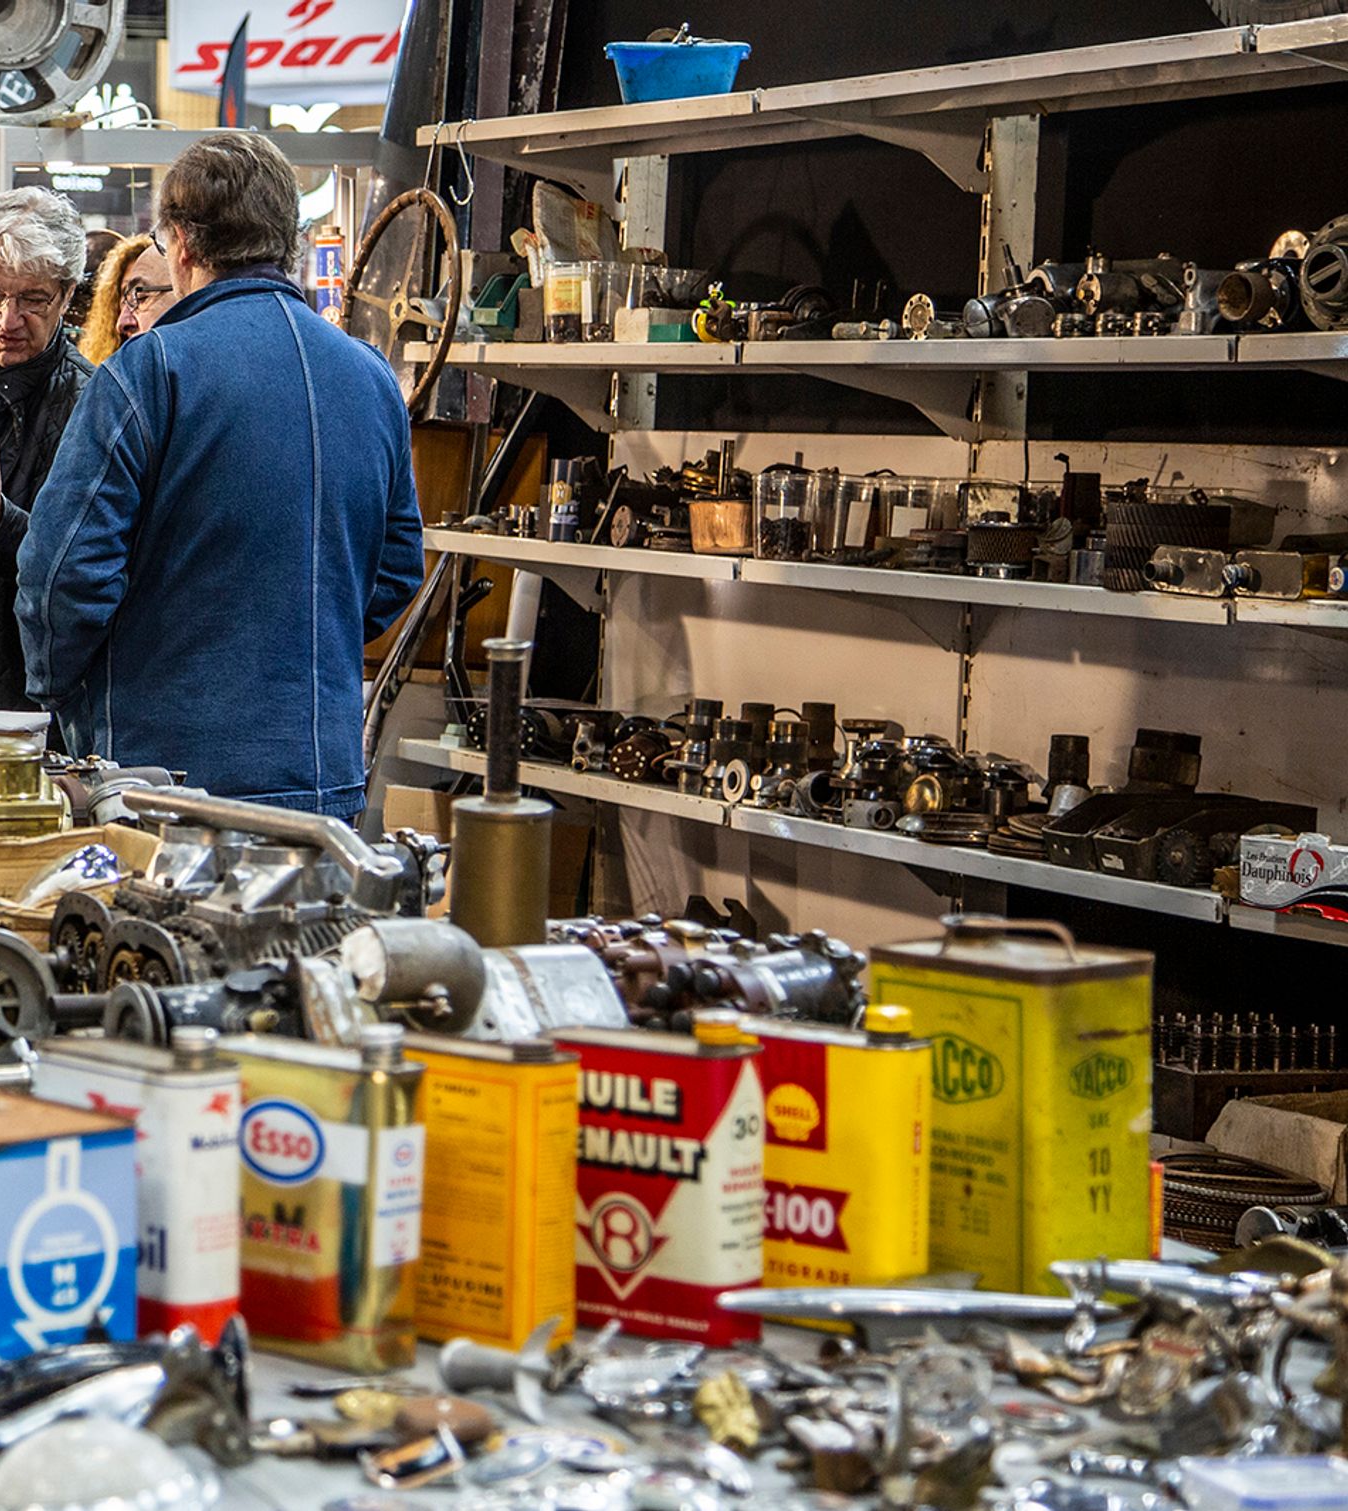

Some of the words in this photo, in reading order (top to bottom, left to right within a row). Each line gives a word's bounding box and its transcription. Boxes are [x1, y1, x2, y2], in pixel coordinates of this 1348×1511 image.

[1242, 861, 1313, 884] Dauphinois
[1070, 1057, 1127, 1097] YACCO
[774, 1104, 812, 1121] SHELL
[767, 1259, 851, 1286] TIGRADE
